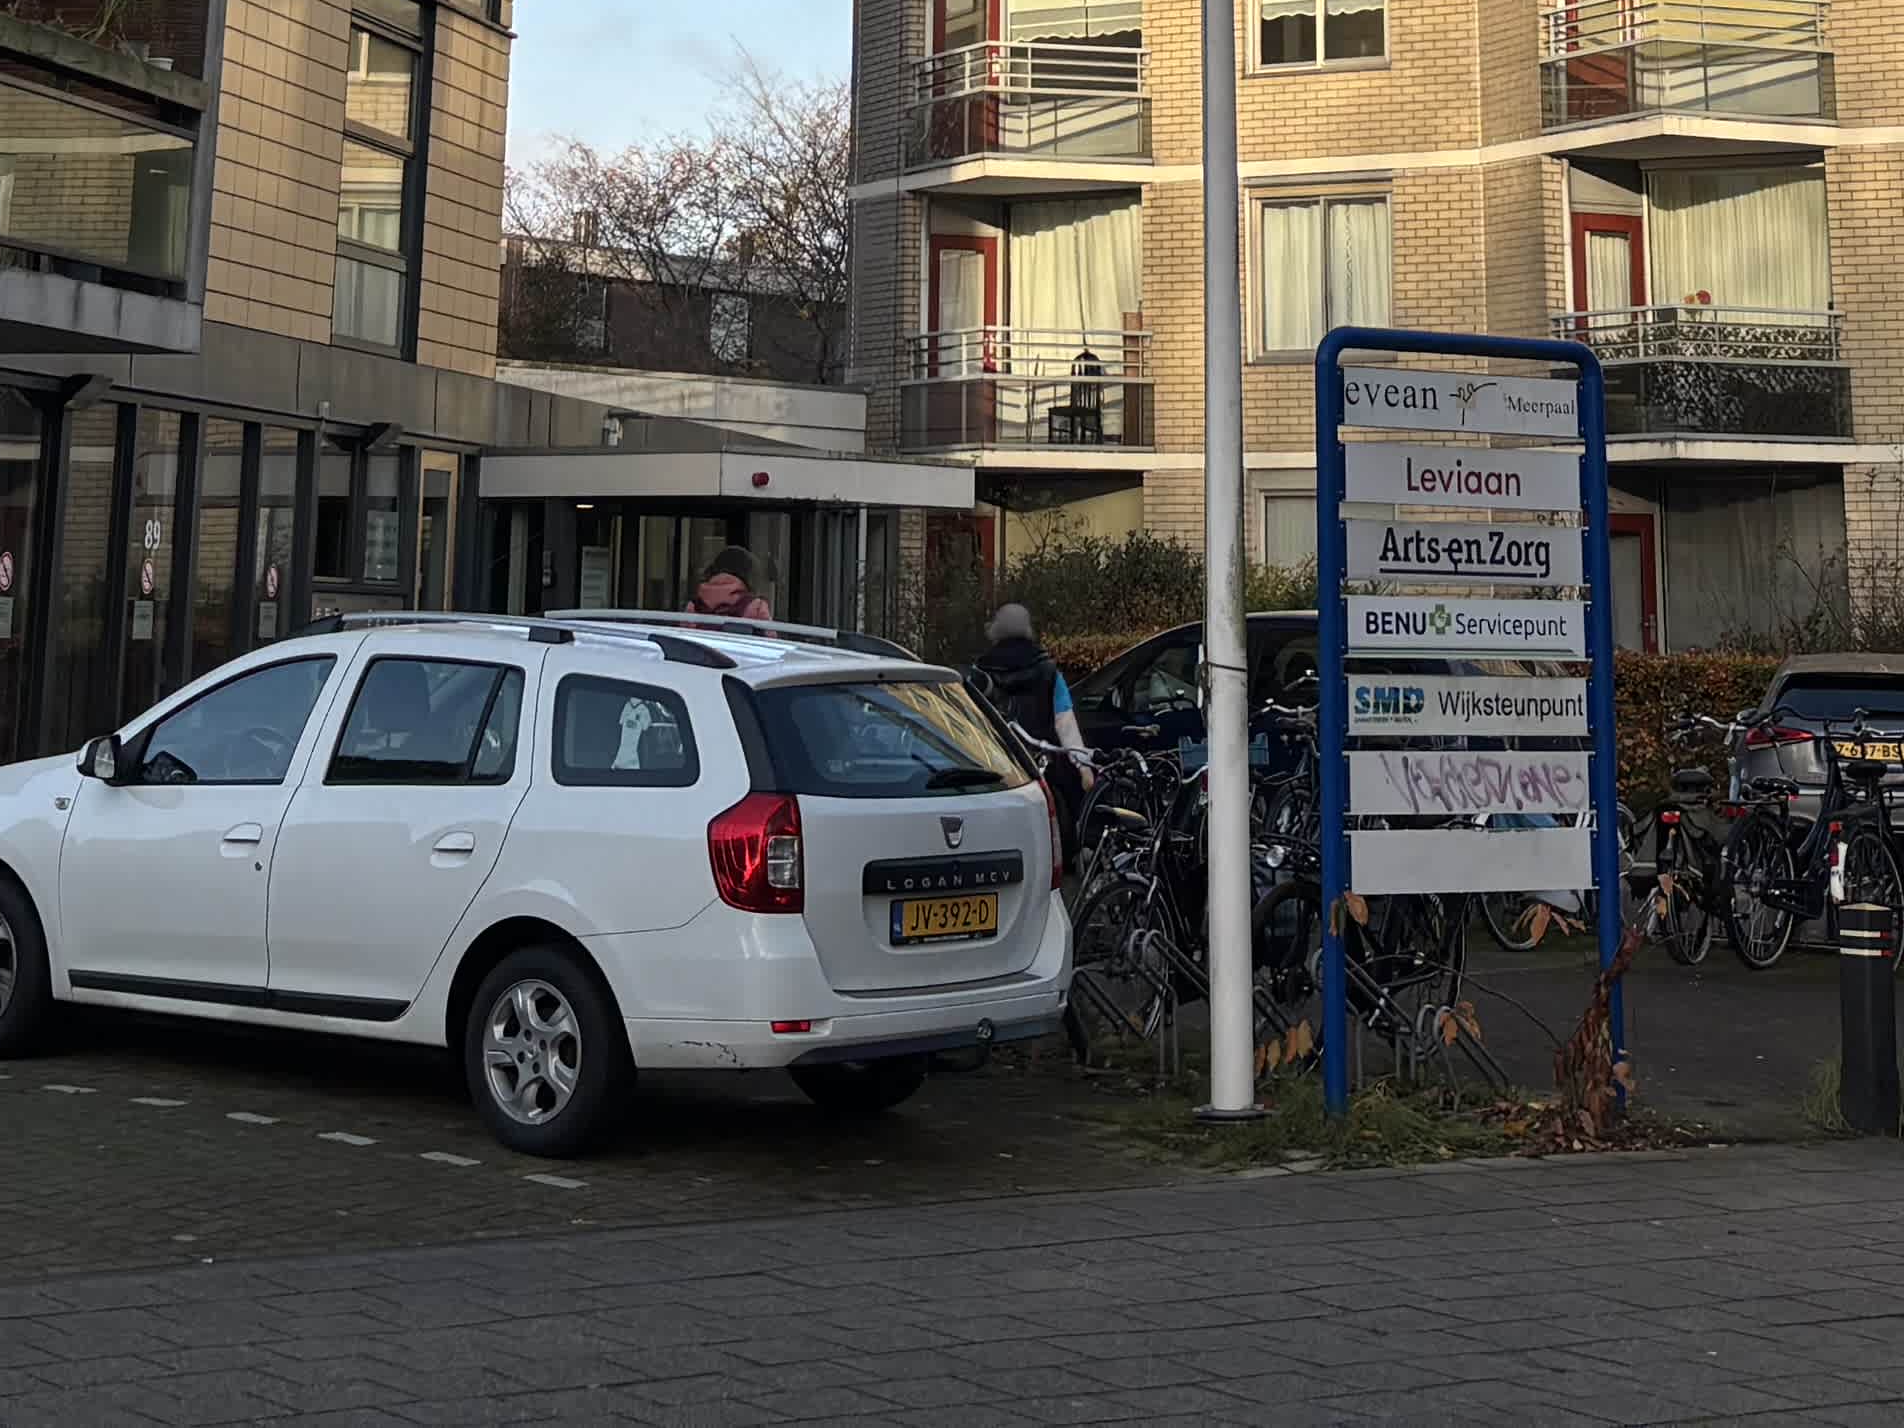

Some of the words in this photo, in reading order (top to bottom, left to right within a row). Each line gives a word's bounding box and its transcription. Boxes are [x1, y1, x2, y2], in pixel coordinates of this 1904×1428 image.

[1344, 380, 1440, 411] evean
[1406, 457, 1521, 496] Leviaan
[144, 519, 161, 550] 89
[1365, 611, 1427, 635] BENU
[1455, 612, 1568, 640] Servicepunt
[1354, 685, 1425, 715] SMD
[1438, 690, 1585, 722] Wijksteunpunt
[886, 874, 963, 890] LOGAN
[910, 898, 990, 931] JV-392-D
